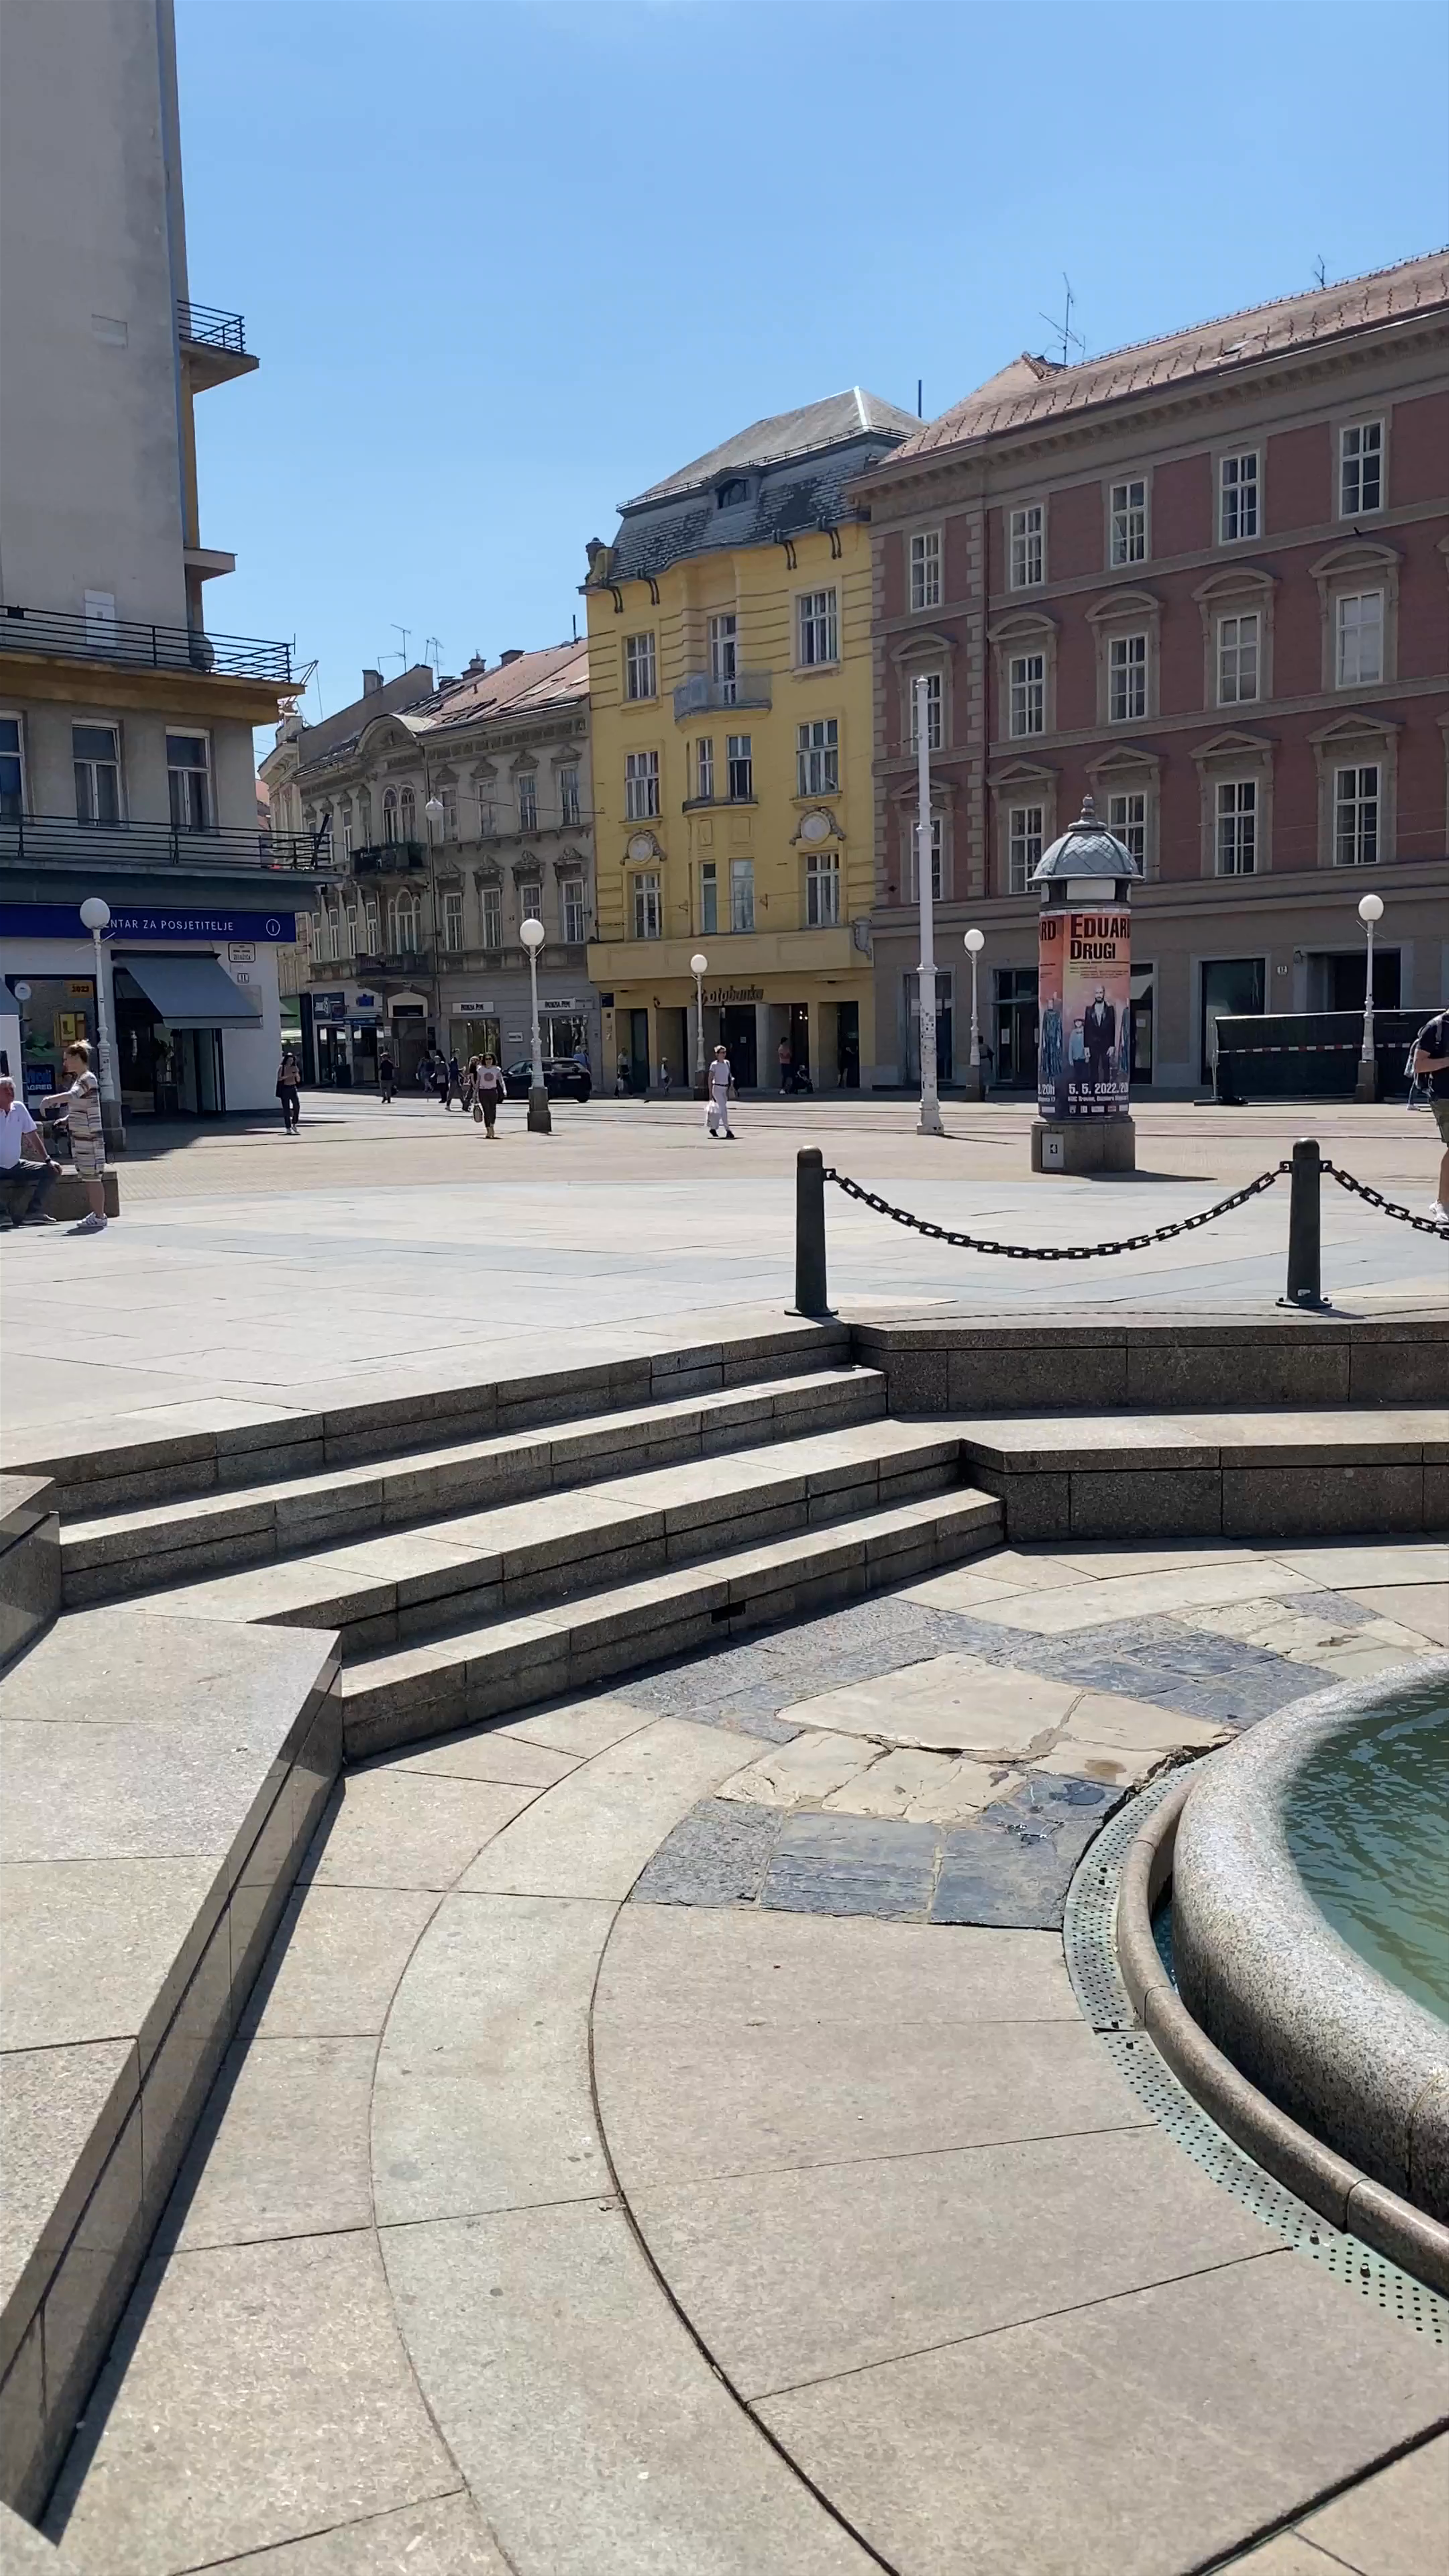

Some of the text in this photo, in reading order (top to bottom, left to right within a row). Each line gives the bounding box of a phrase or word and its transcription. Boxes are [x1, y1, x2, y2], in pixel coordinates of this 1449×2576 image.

[107, 920, 234, 930] NTAR ZA POSJETITELJE
[1070, 940, 1116, 959] DRUGI
[1068, 1083, 1078, 1094] 5.
[1081, 1083, 1092, 1094] 5.
